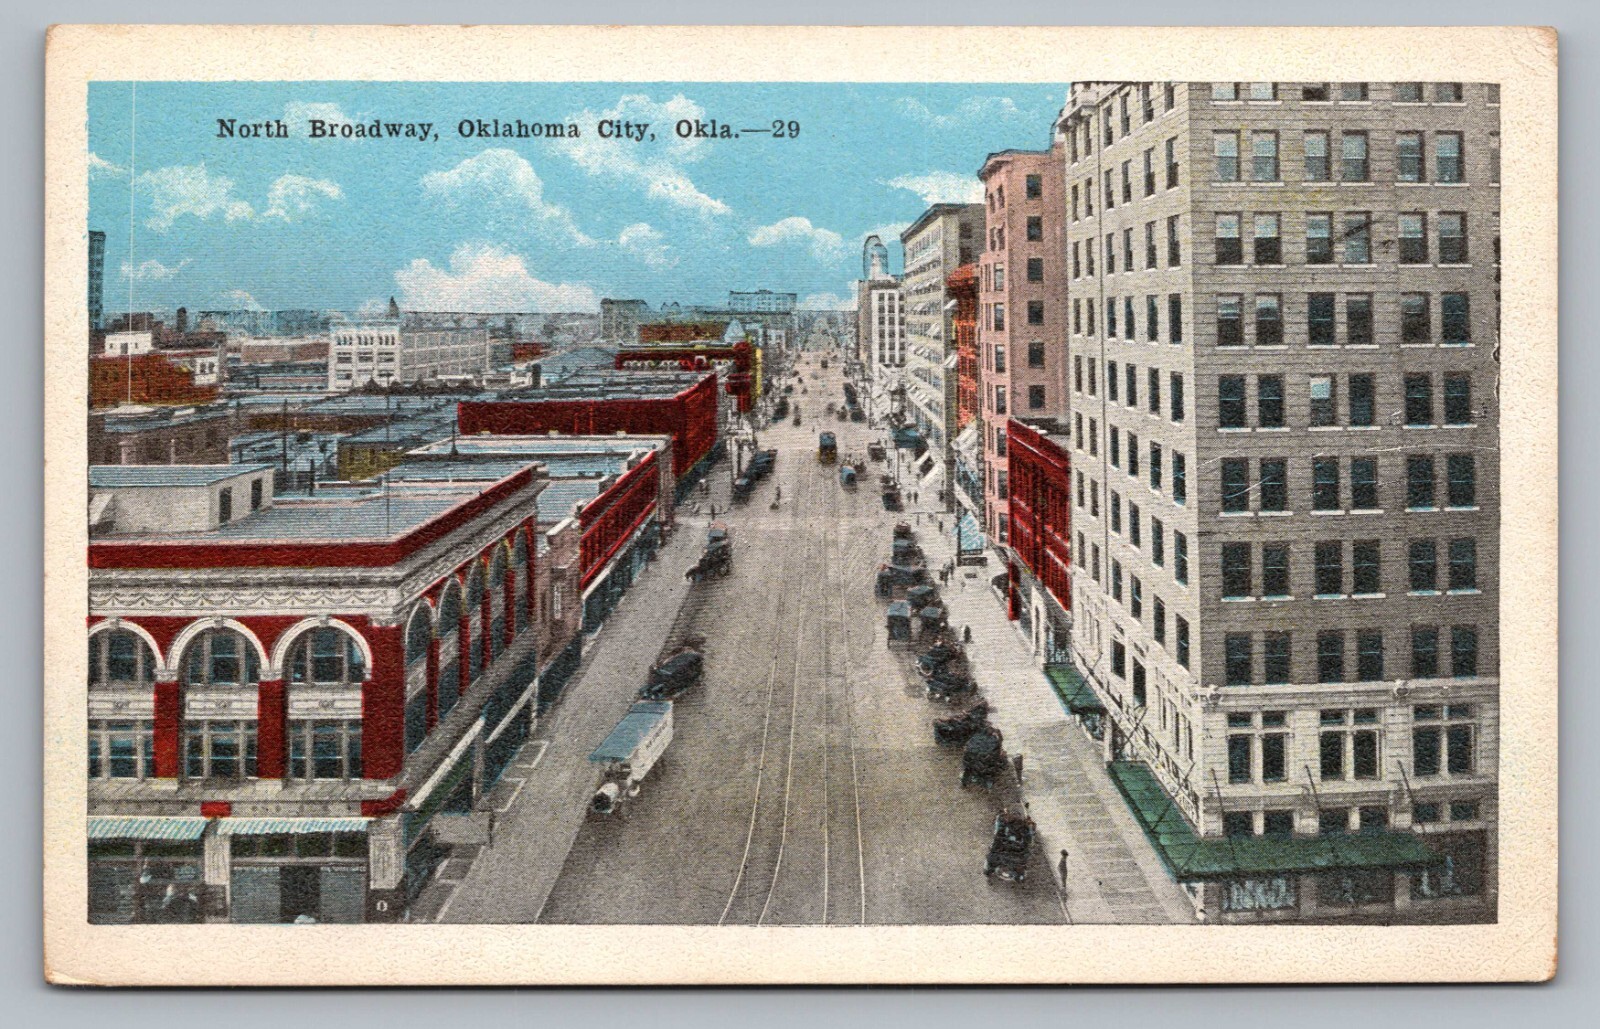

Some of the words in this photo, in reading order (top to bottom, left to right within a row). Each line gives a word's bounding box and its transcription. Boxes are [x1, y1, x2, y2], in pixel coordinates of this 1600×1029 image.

[217, 118, 288, 138] North
[309, 119, 439, 141] Broadway,
[458, 119, 579, 138] Oklahoma
[598, 120, 655, 141] City,
